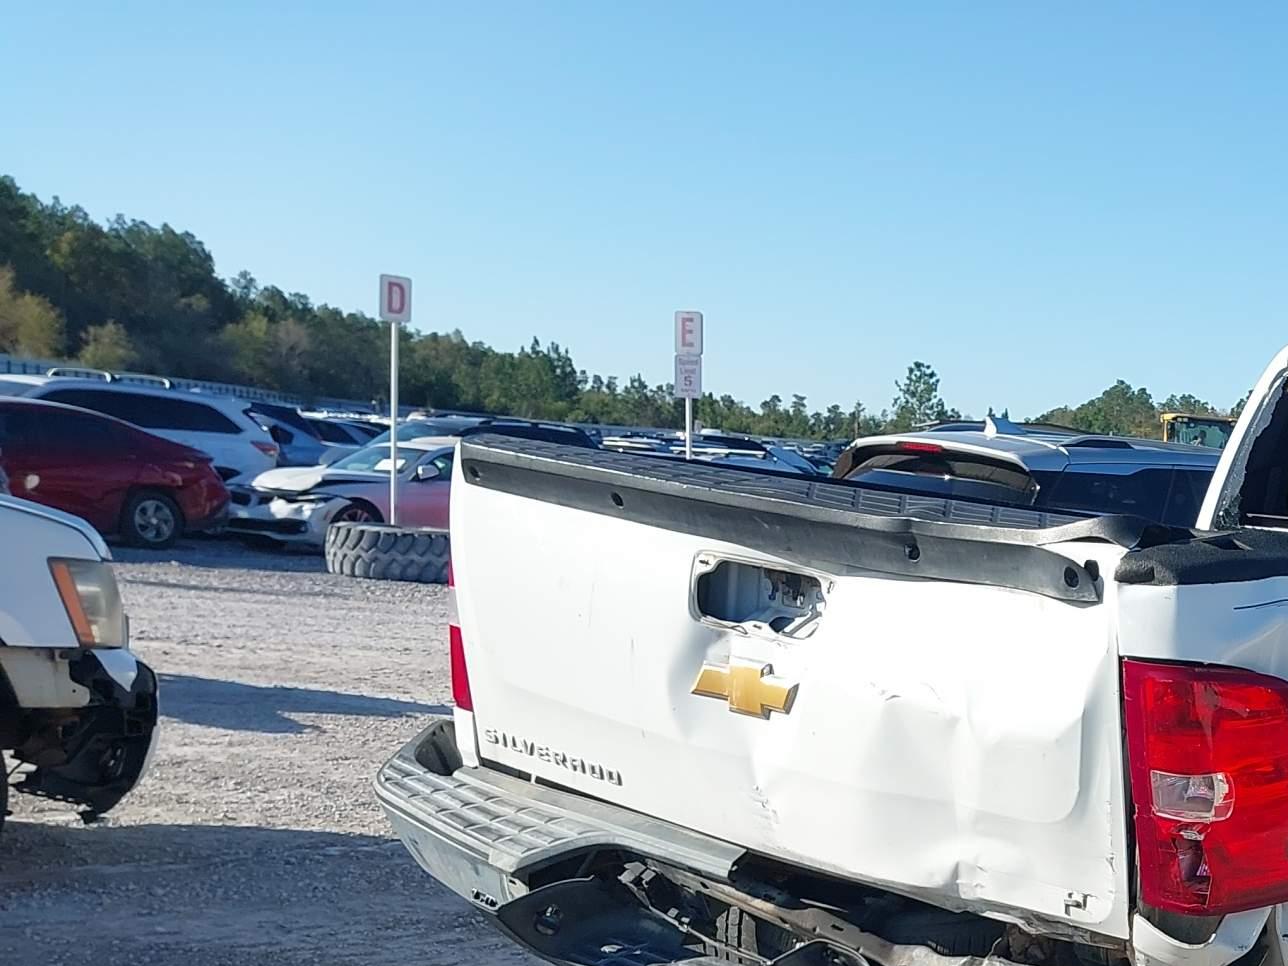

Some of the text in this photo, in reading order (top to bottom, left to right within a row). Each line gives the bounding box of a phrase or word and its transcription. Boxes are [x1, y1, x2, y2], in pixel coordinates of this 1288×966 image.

[387, 281, 405, 314] D
[681, 317, 694, 347] E
[684, 375, 692, 387] 5
[484, 728, 623, 786] SILVERADO
